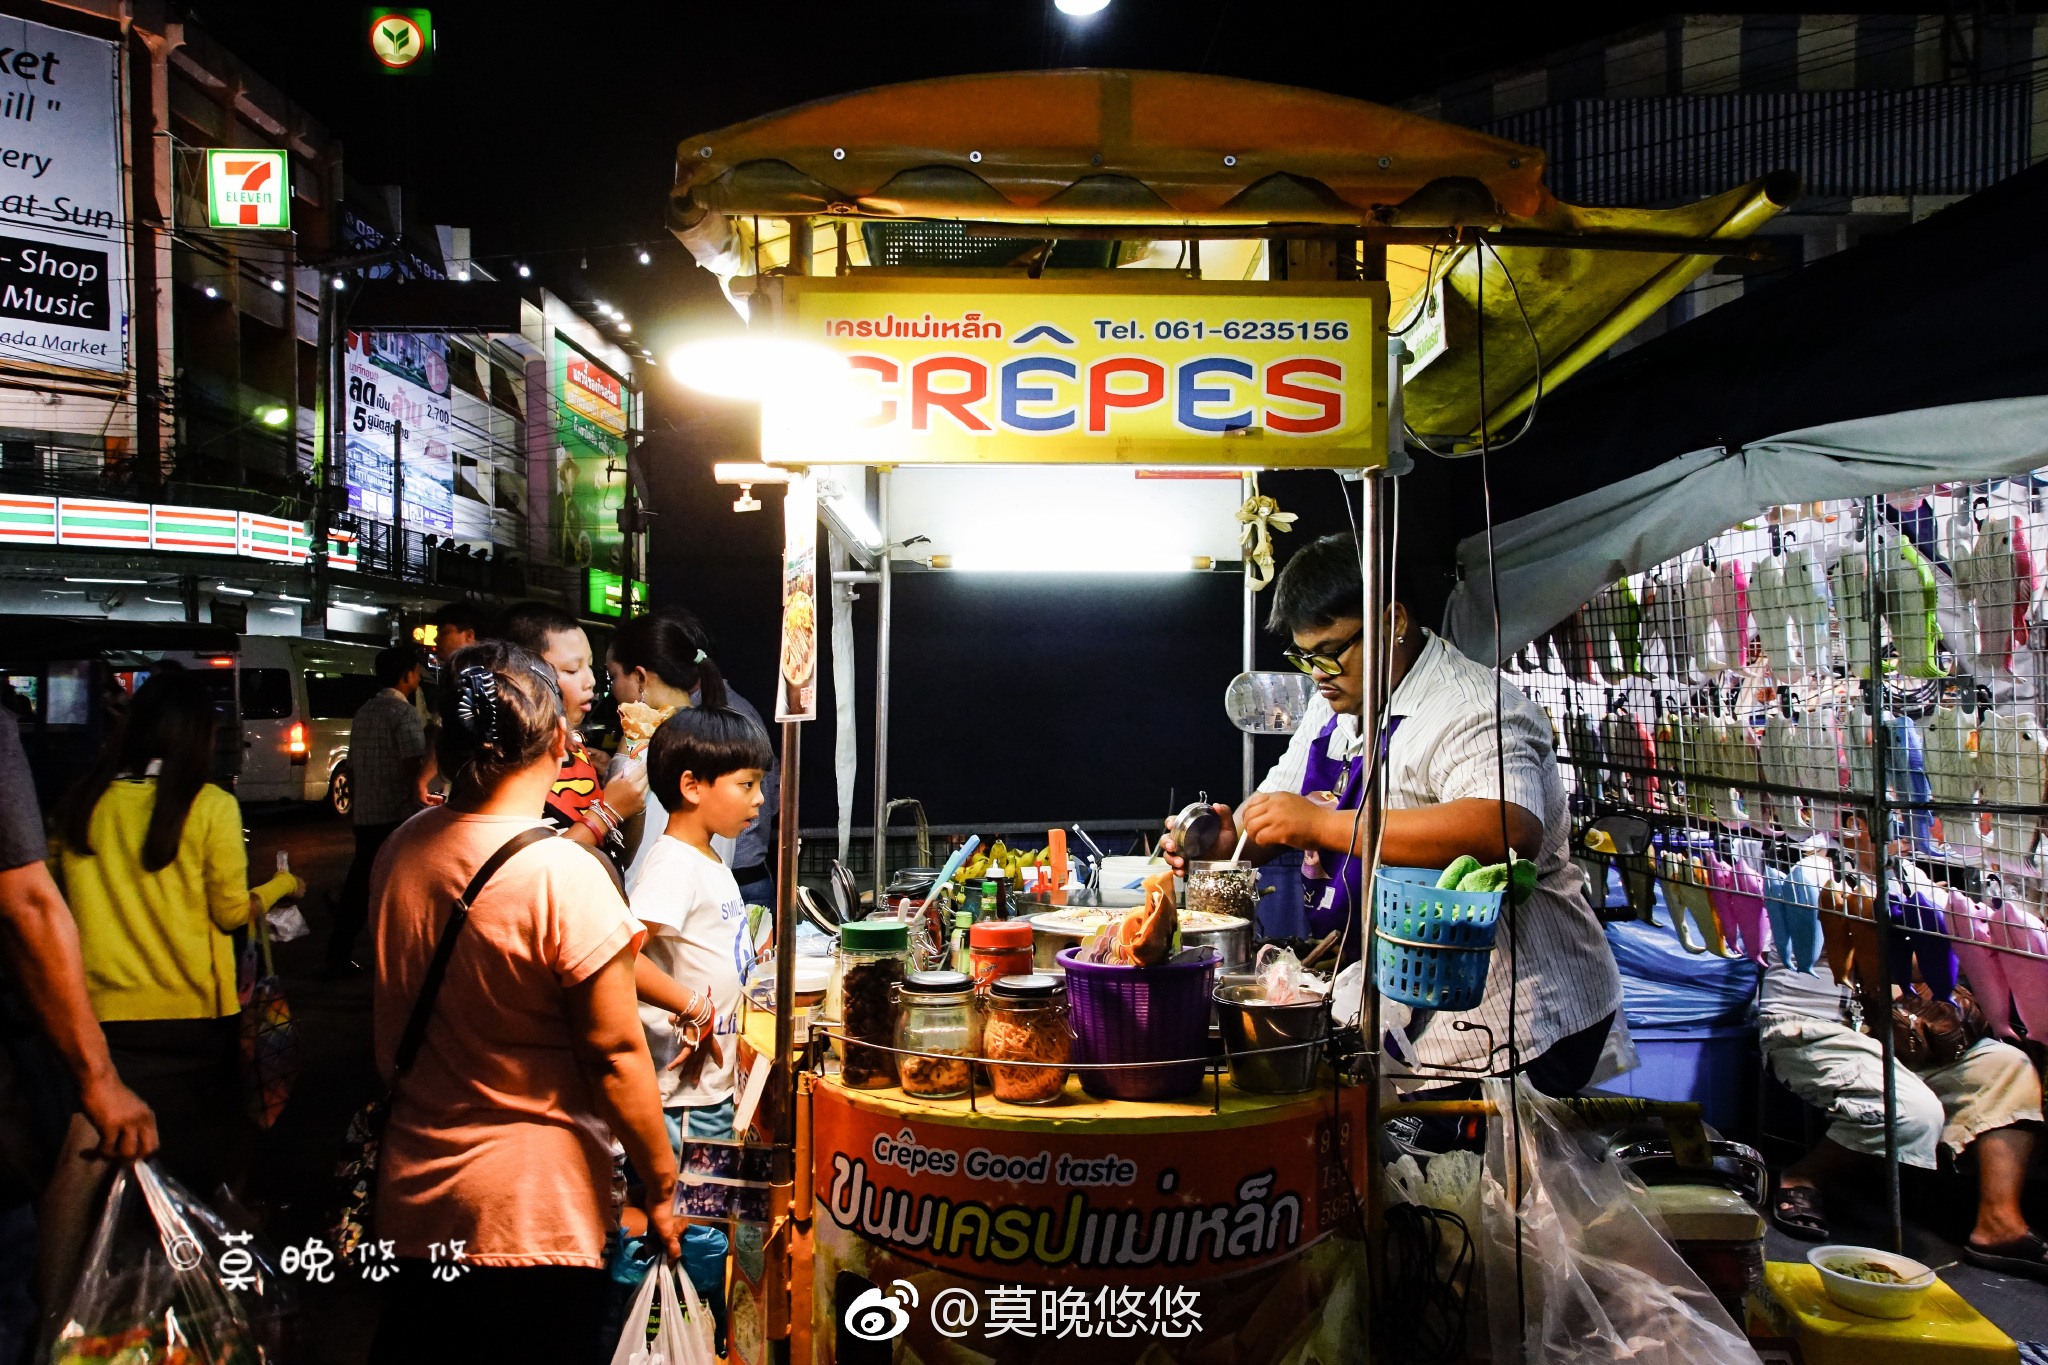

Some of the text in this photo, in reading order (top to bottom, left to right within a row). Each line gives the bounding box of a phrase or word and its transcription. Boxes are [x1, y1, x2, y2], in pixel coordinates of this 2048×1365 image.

[1, 92, 35, 121] ill
[1, 149, 52, 178] ery
[19, 249, 98, 286] Shop
[2, 285, 94, 319] Music
[826, 313, 1002, 338] เครปแม่เหล็ก
[1094, 321, 1349, 340] Tel. 061-6235156
[43, 334, 107, 356] Market
[874, 1130, 1135, 1183] Crêpes Good taste
